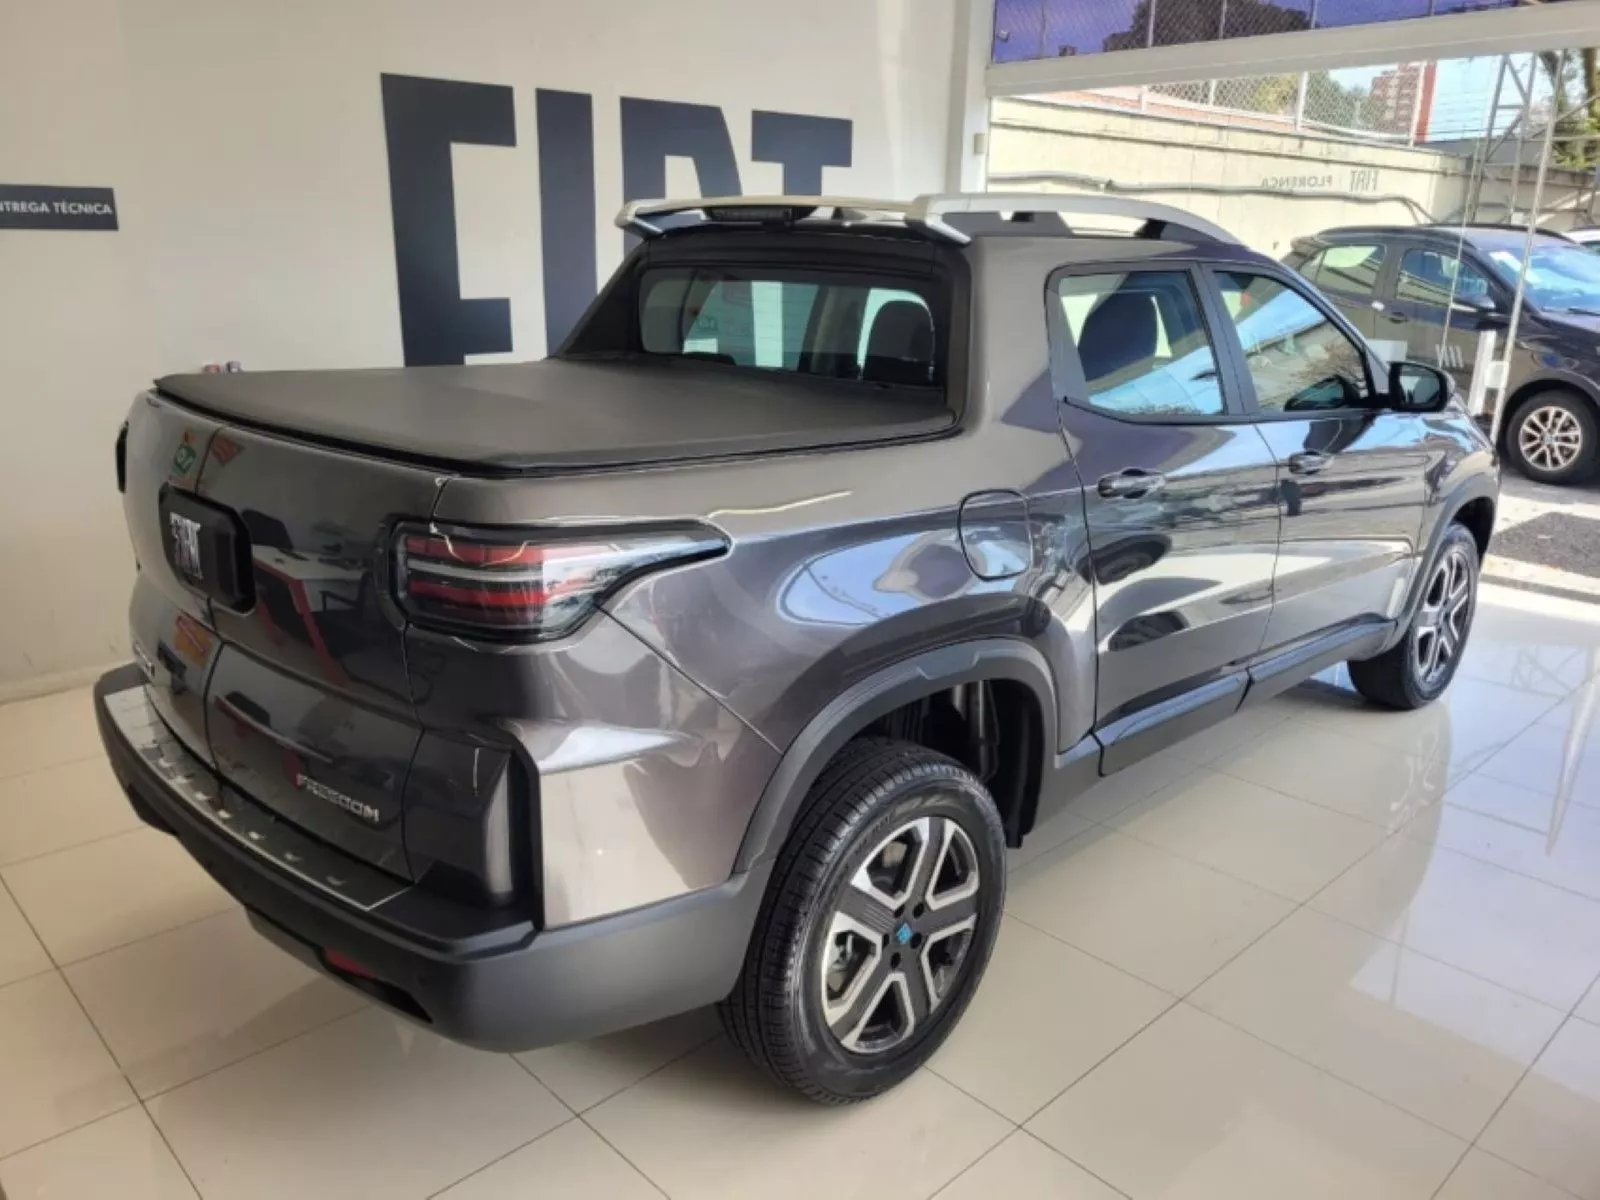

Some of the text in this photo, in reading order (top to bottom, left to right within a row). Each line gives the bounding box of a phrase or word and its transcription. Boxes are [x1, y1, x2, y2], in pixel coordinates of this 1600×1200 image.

[52, 199, 113, 215] TÉCNICA
[380, 72, 853, 368] FI
[296, 772, 380, 823] FREEDOM
